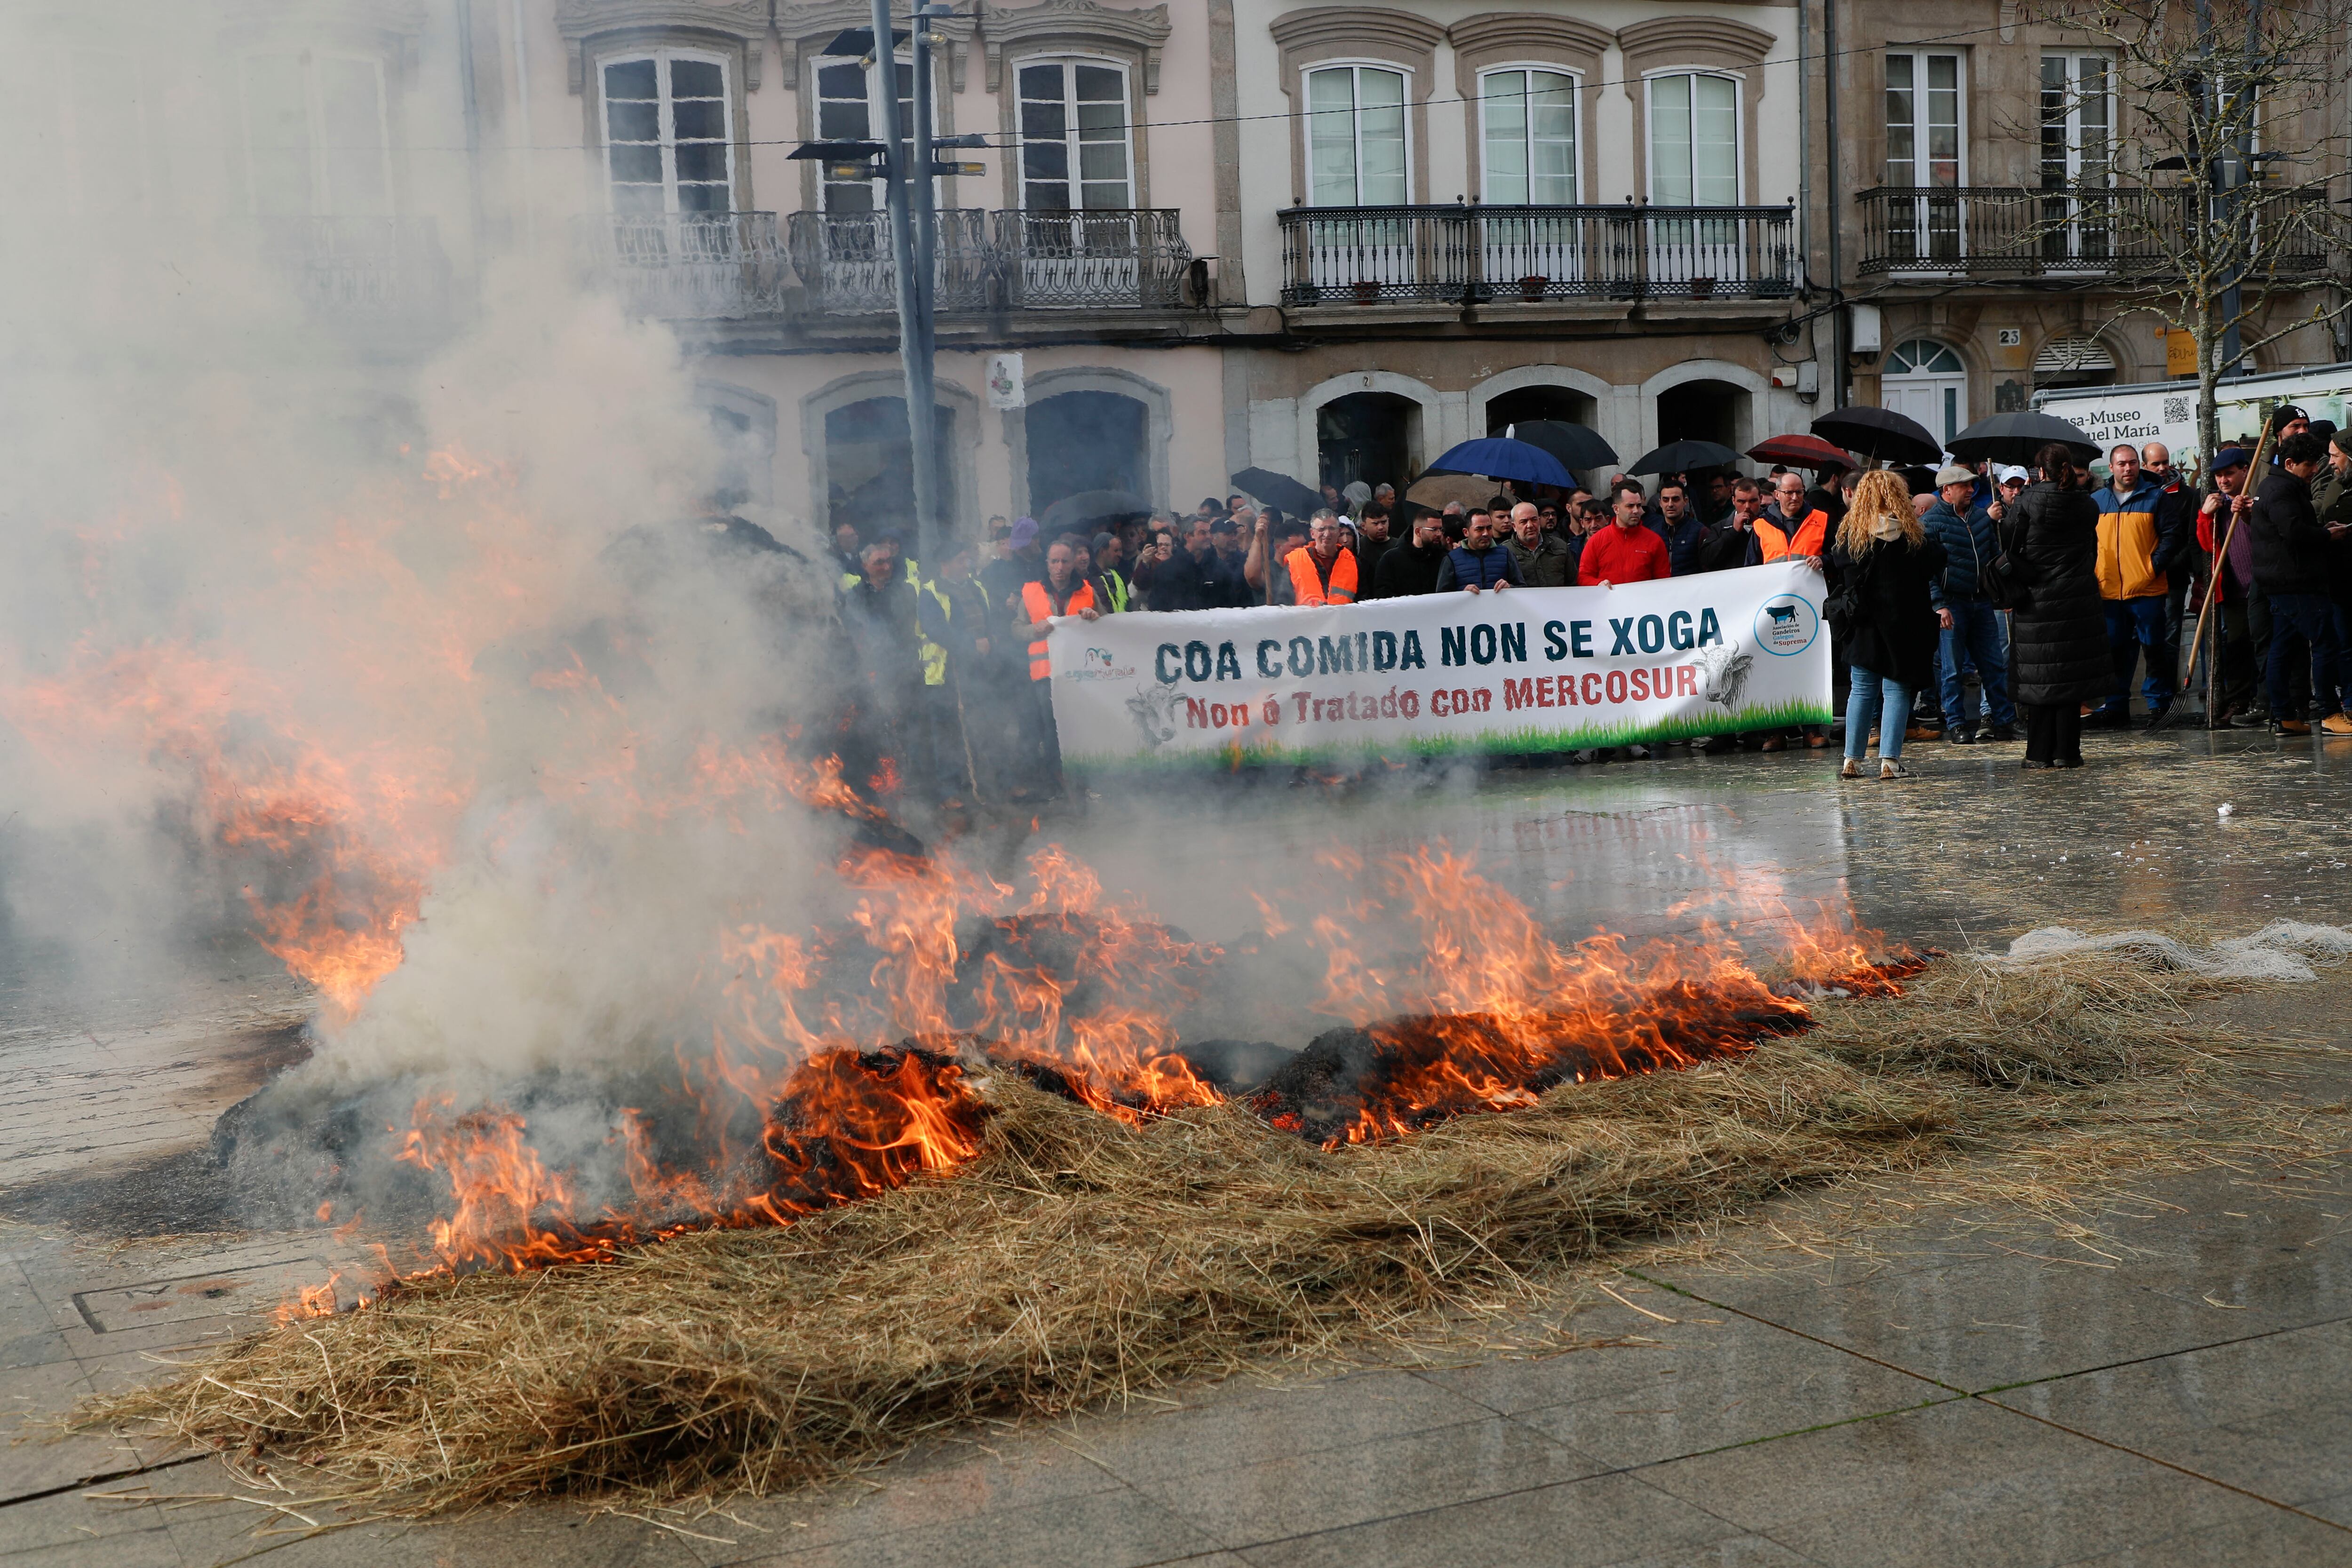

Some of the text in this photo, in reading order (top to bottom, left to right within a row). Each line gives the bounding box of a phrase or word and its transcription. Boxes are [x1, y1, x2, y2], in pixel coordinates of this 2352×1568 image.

[2001, 331, 2018, 344] 23
[2057, 411, 2140, 426] sa-Museo
[2295, 408, 2306, 417] LA
[2086, 423, 2160, 441] uel María
[1155, 607, 1724, 684] COA COMIDA NON SE XOGA
[1186, 665, 1698, 728] Non ó Tratado con MERCOSUR
